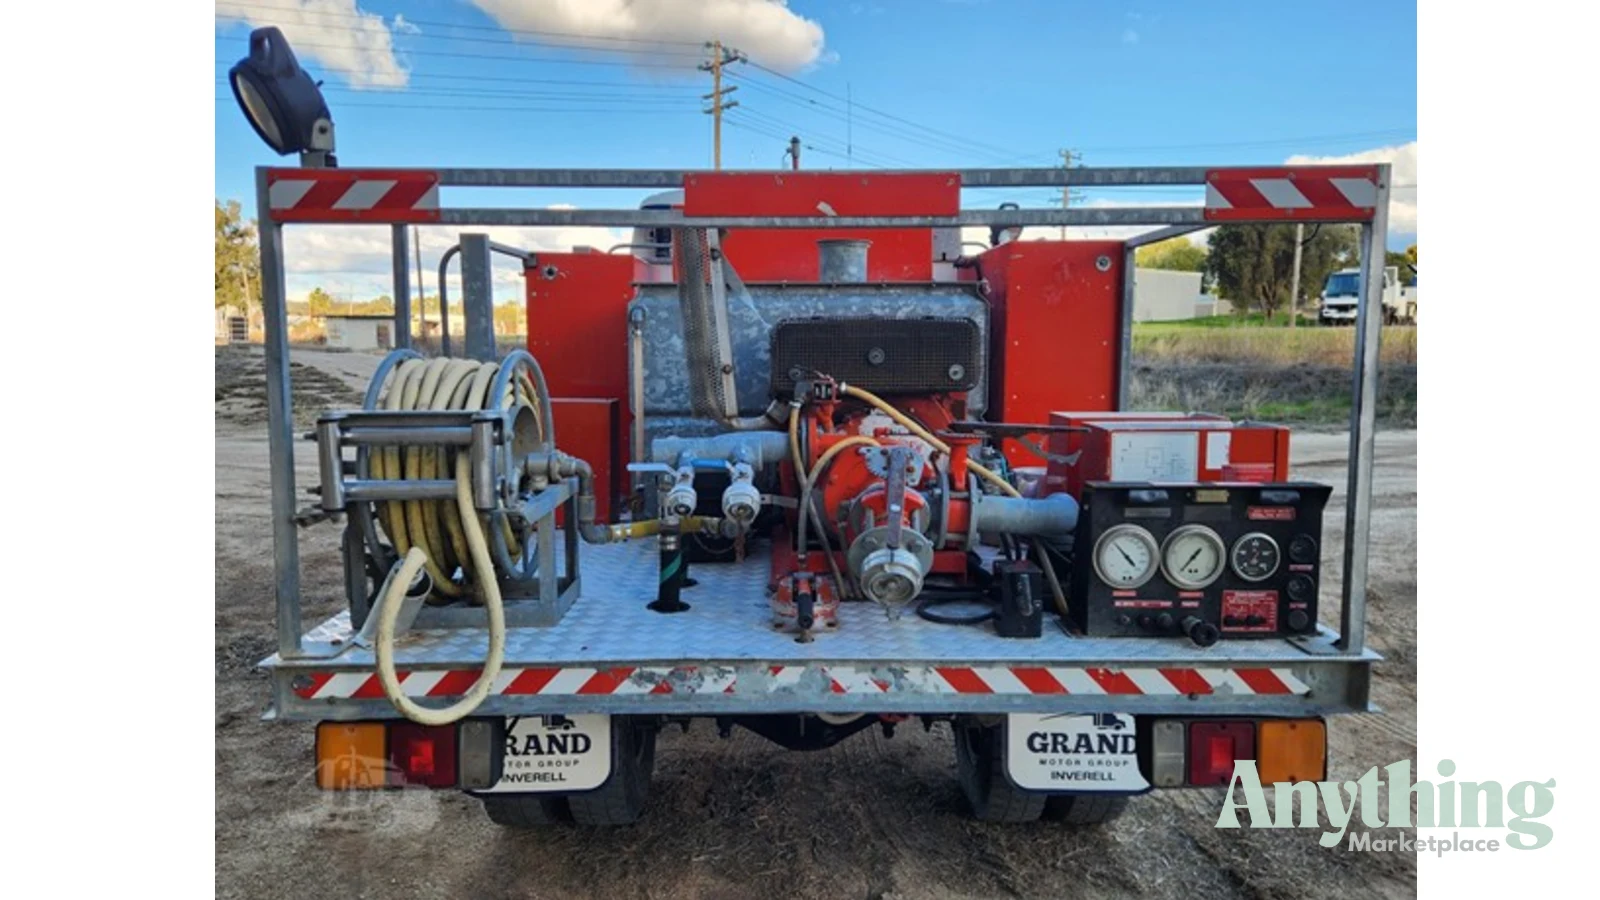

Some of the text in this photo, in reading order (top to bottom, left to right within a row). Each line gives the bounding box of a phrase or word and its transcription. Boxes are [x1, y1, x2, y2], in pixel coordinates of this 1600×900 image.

[504, 733, 591, 756] RAND
[503, 759, 580, 768] TOR GROUP
[1088, 759, 1129, 767] GROUP
[1051, 771, 1115, 781] INVERELL
